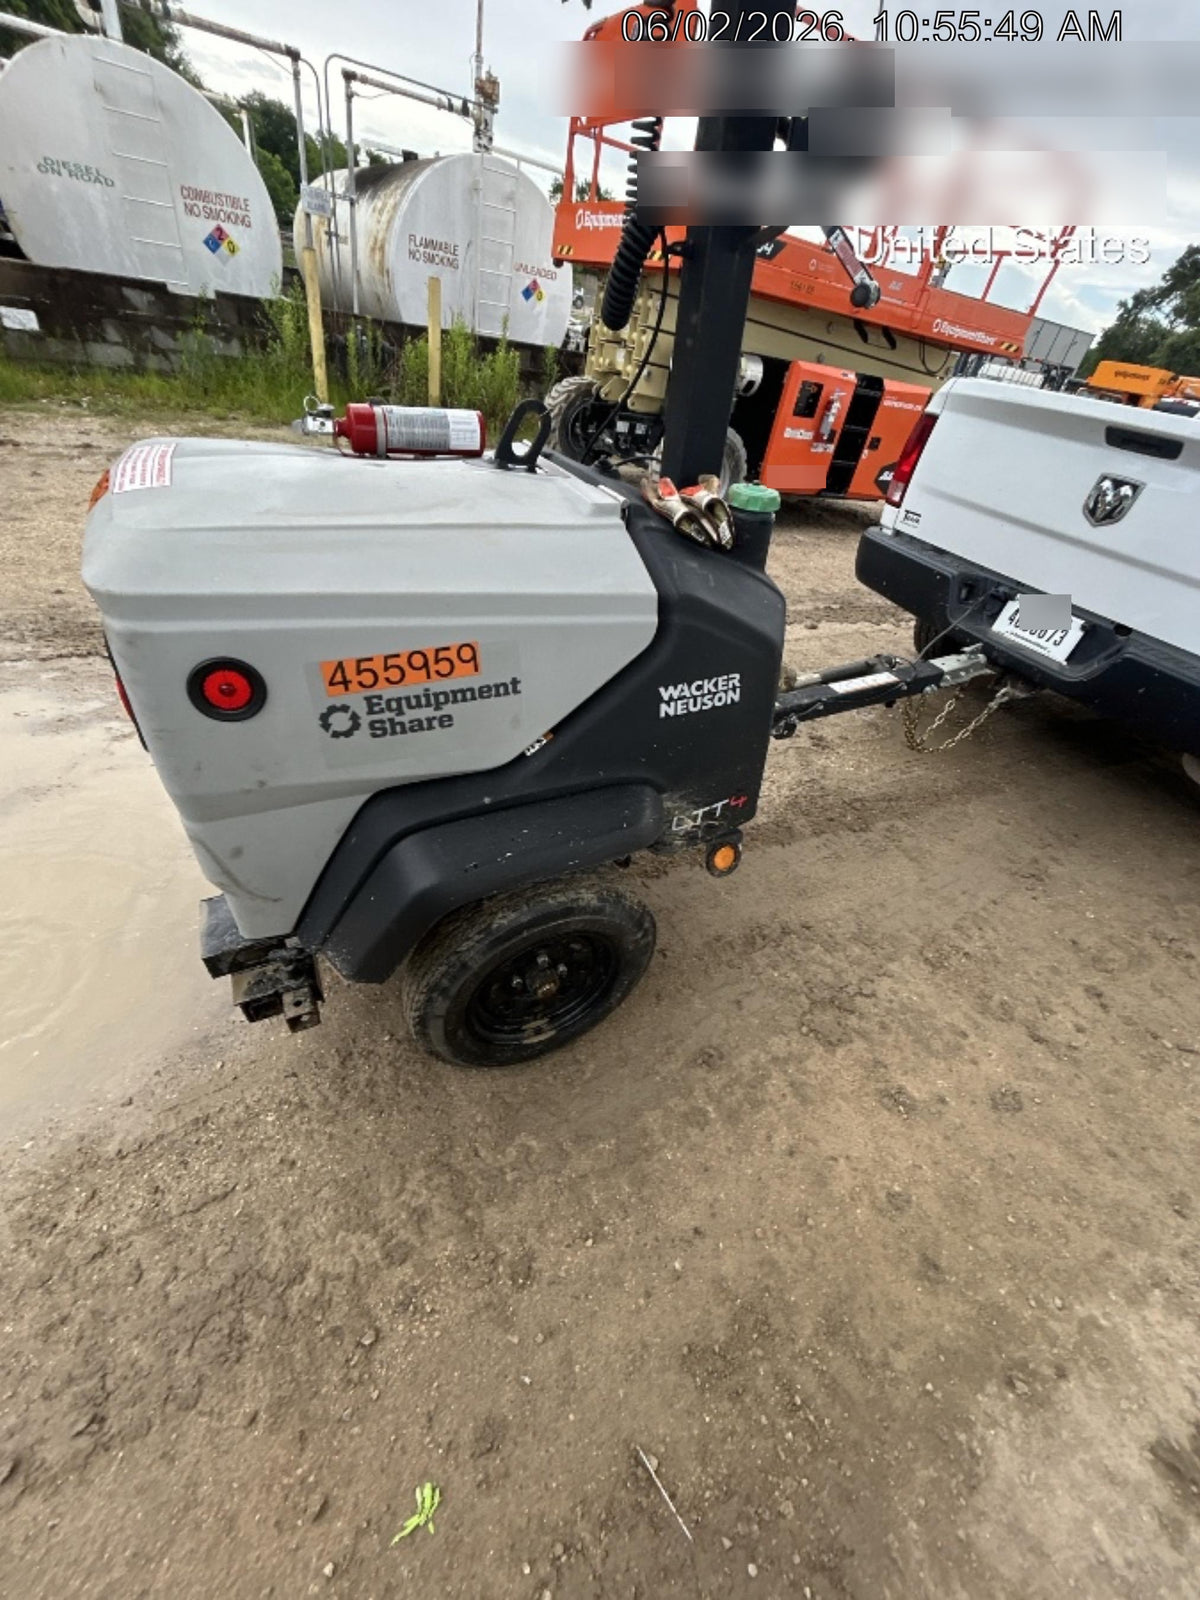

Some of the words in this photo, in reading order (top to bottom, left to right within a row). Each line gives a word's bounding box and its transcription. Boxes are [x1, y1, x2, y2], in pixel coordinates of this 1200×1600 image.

[36, 162, 63, 177] ON
[68, 169, 115, 188] ROAD
[43, 156, 105, 178] DIESEL
[180, 184, 250, 212] COMBUSTIBLE
[184, 202, 201, 218] NO
[202, 206, 252, 228] SMOKING
[216, 226, 224, 241] 2
[408, 234, 459, 257] FLAMMABLE
[226, 240, 236, 254] 0
[408, 249, 421, 261] NO
[423, 251, 459, 270] SMOKING
[514, 263, 557, 281] UNLEADED
[328, 643, 479, 692] 455959
[363, 677, 521, 716] Equipment
[658, 673, 741, 701] WACKER
[659, 688, 741, 718] NEUSON
[369, 714, 454, 738] Share
